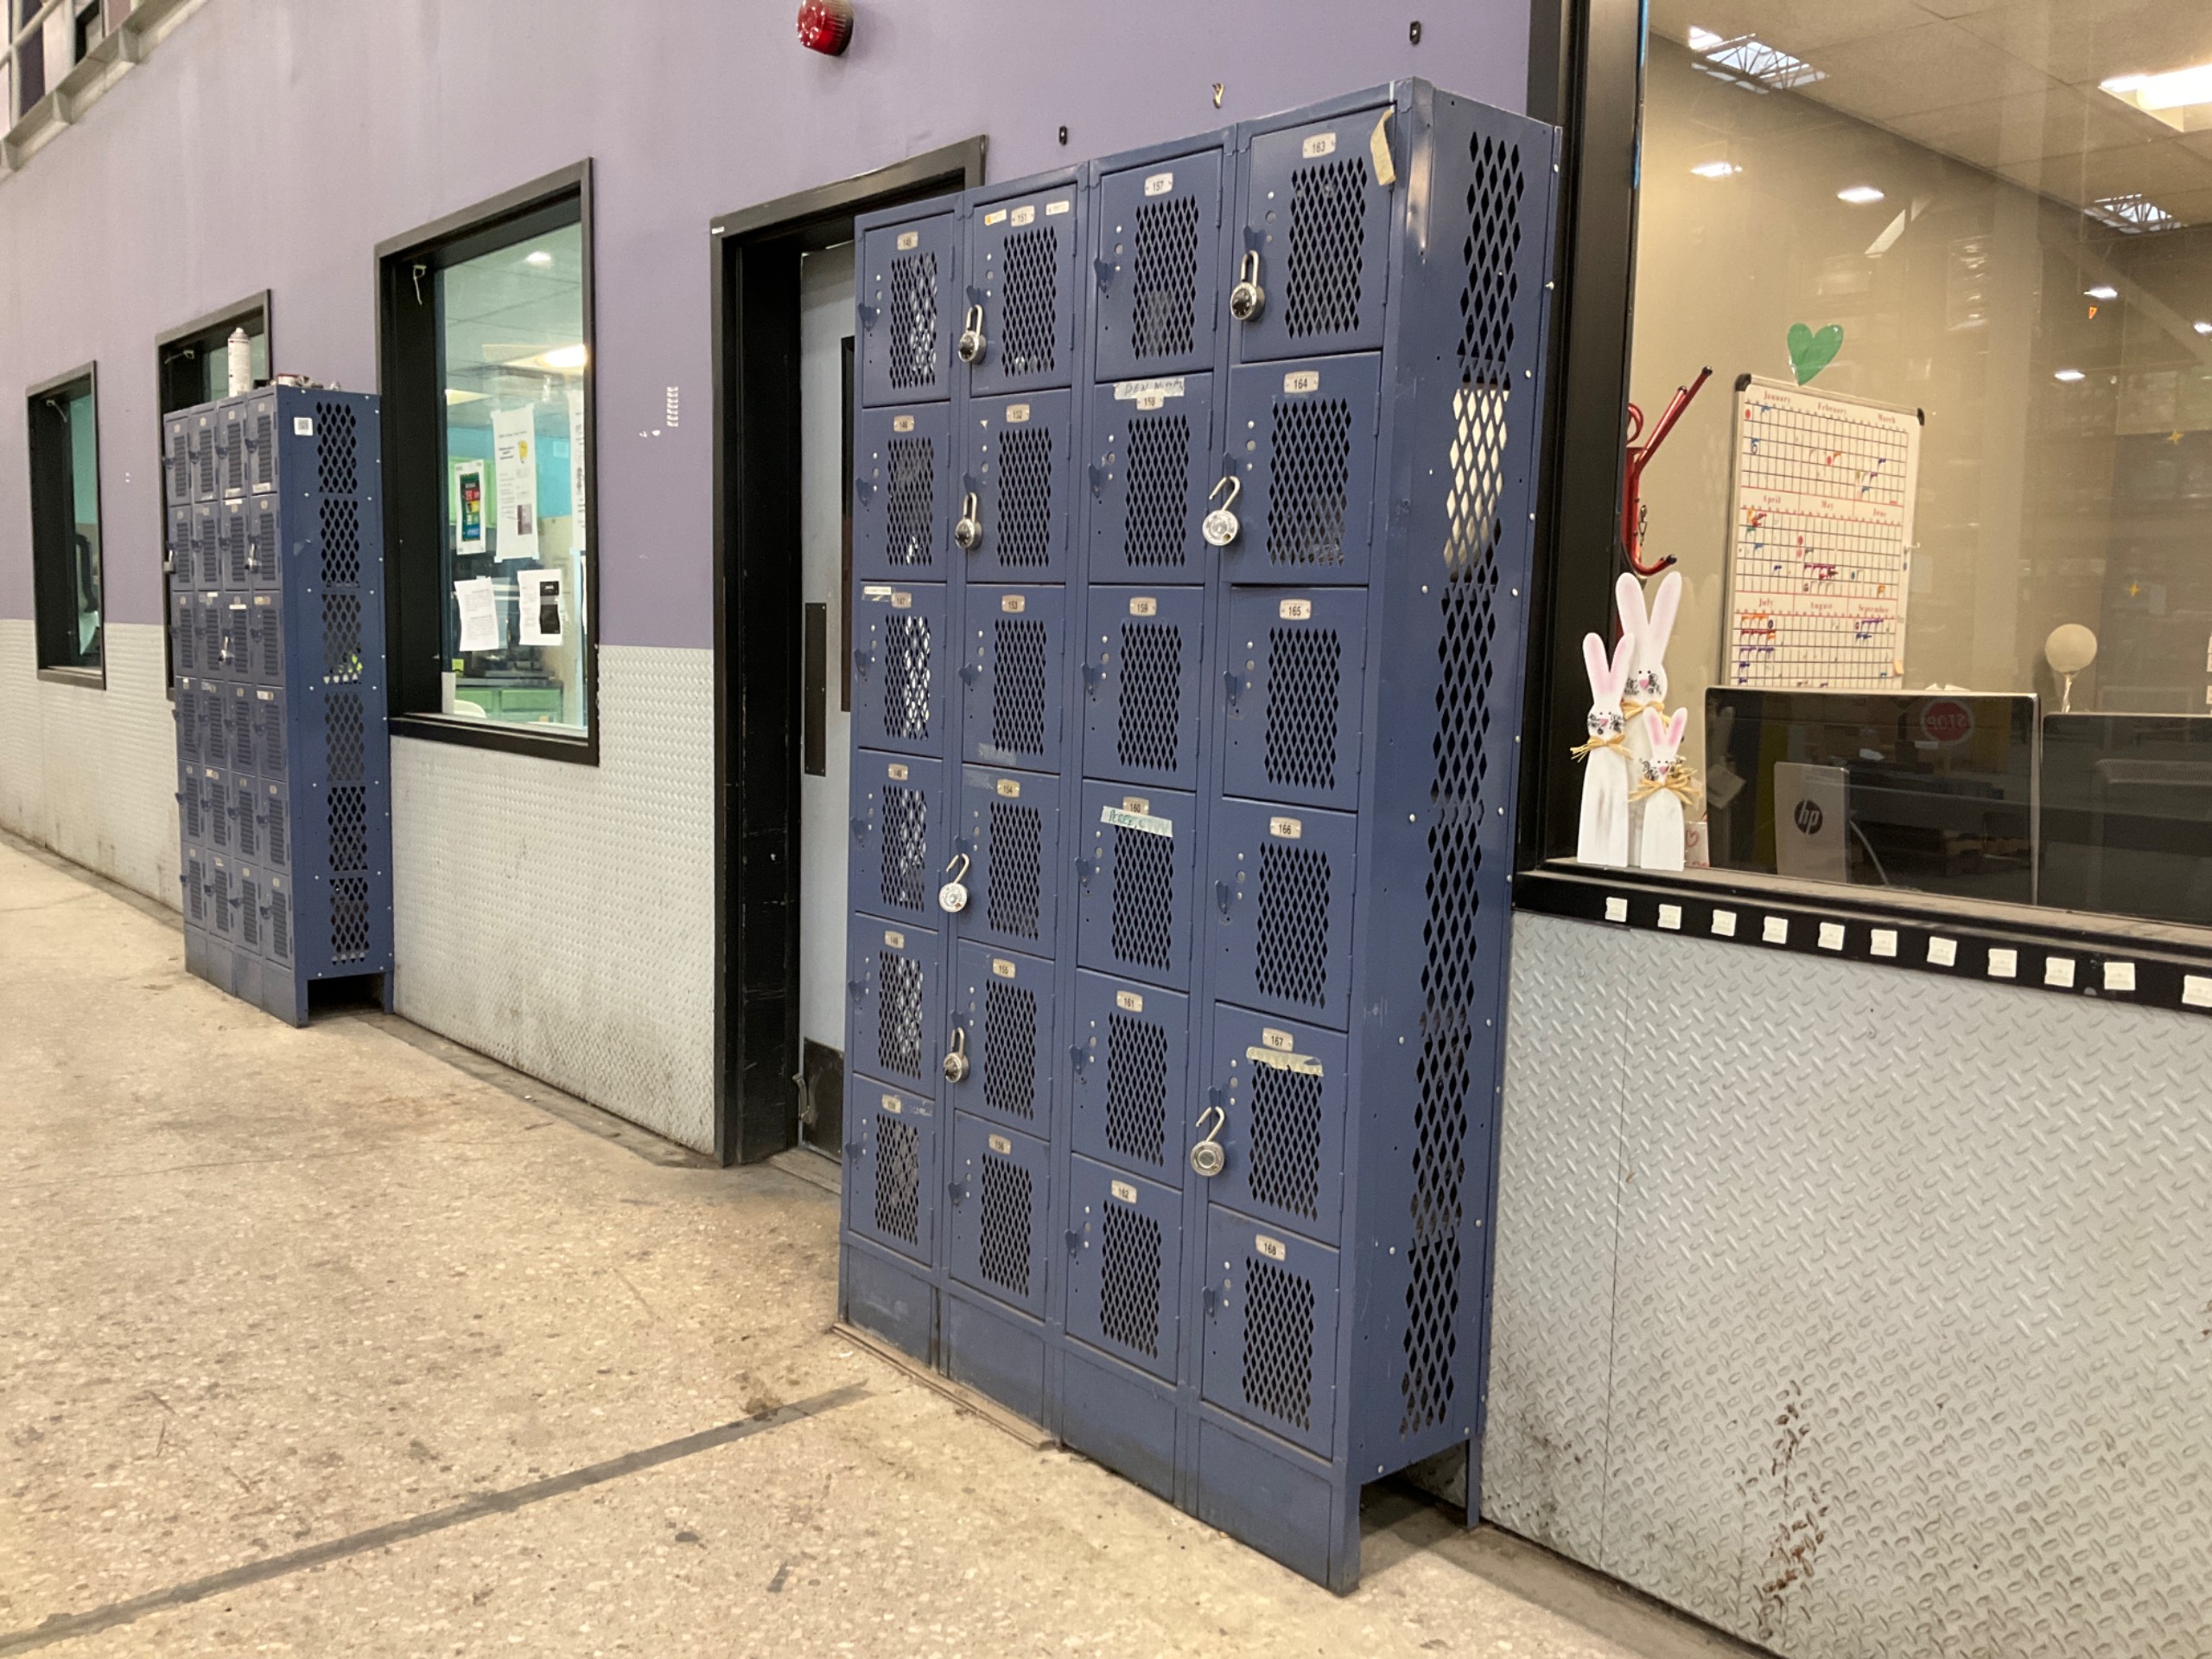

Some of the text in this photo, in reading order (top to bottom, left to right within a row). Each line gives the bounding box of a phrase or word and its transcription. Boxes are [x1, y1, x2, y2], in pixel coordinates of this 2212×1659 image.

[1313, 141, 1325, 154] 163
[1153, 180, 1164, 192] 157
[1017, 213, 1027, 223] 151
[1294, 378, 1307, 390] 164
[1288, 606, 1301, 616] 165
[1003, 785, 1013, 794] 154
[1798, 800, 1820, 835] hp
[1279, 823, 1292, 835] 166
[999, 965, 1008, 975] 155
[1123, 997, 1135, 1007] 161
[1271, 1036, 1284, 1046] 167
[1118, 1187, 1128, 1199] 162
[1264, 1243, 1277, 1255] 168
